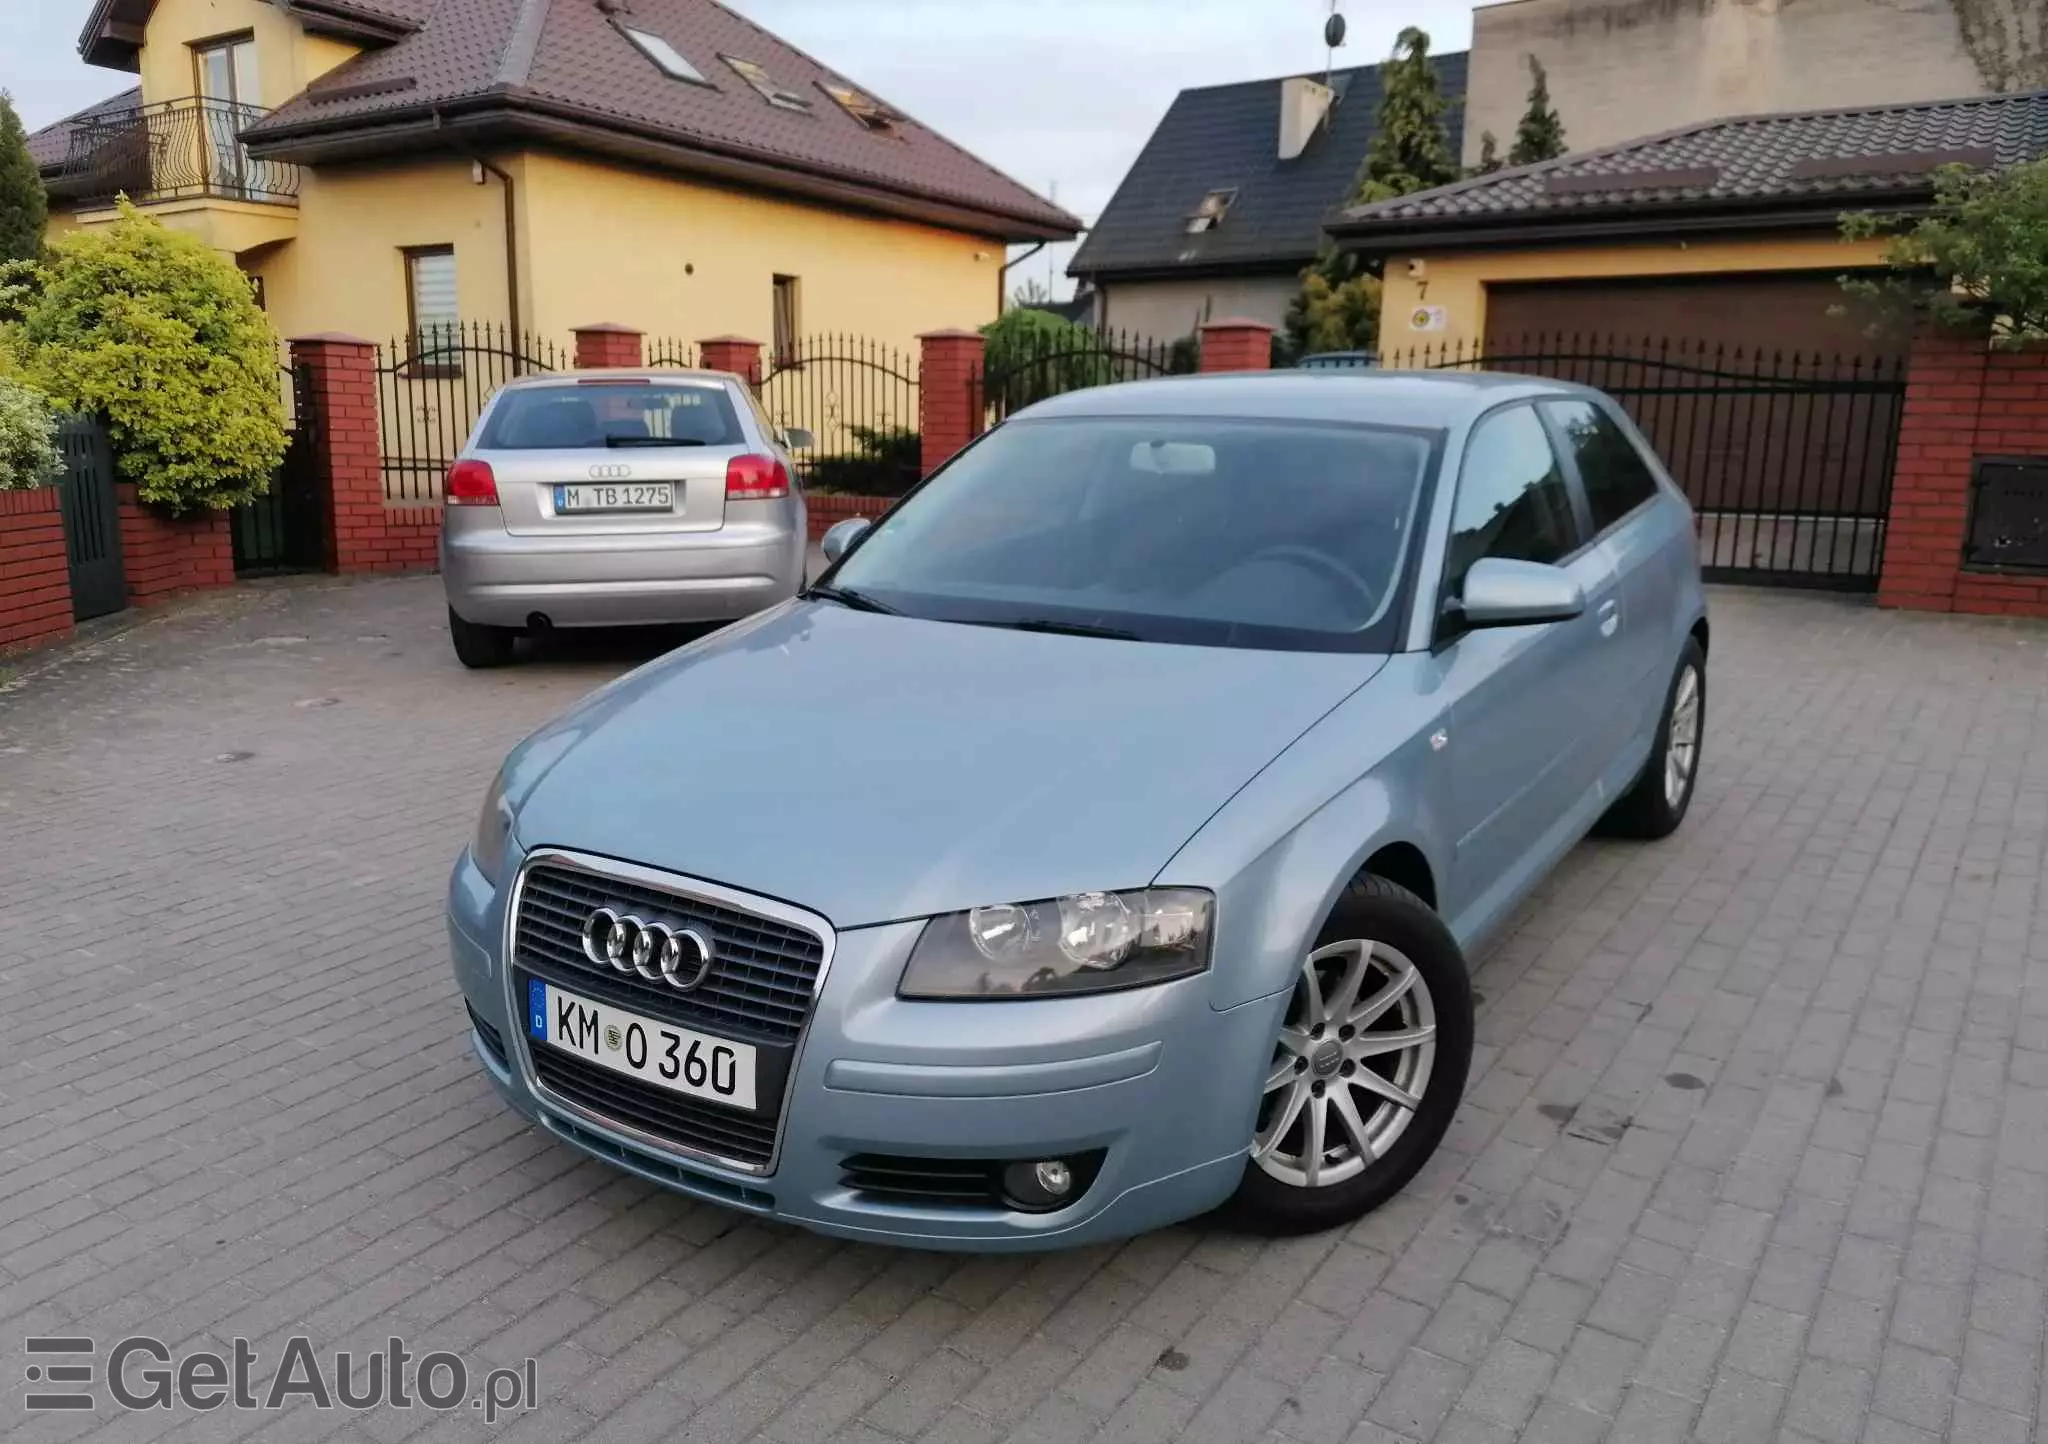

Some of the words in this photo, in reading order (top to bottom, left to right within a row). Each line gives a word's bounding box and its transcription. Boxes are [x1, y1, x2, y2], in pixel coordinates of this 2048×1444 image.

[1416, 280, 1429, 300] 7
[567, 488, 580, 507] M
[593, 487, 617, 506] TB
[623, 486, 669, 505] 1275
[535, 1014, 543, 1028] D
[557, 995, 599, 1055] KM
[658, 1030, 736, 1096] 360
